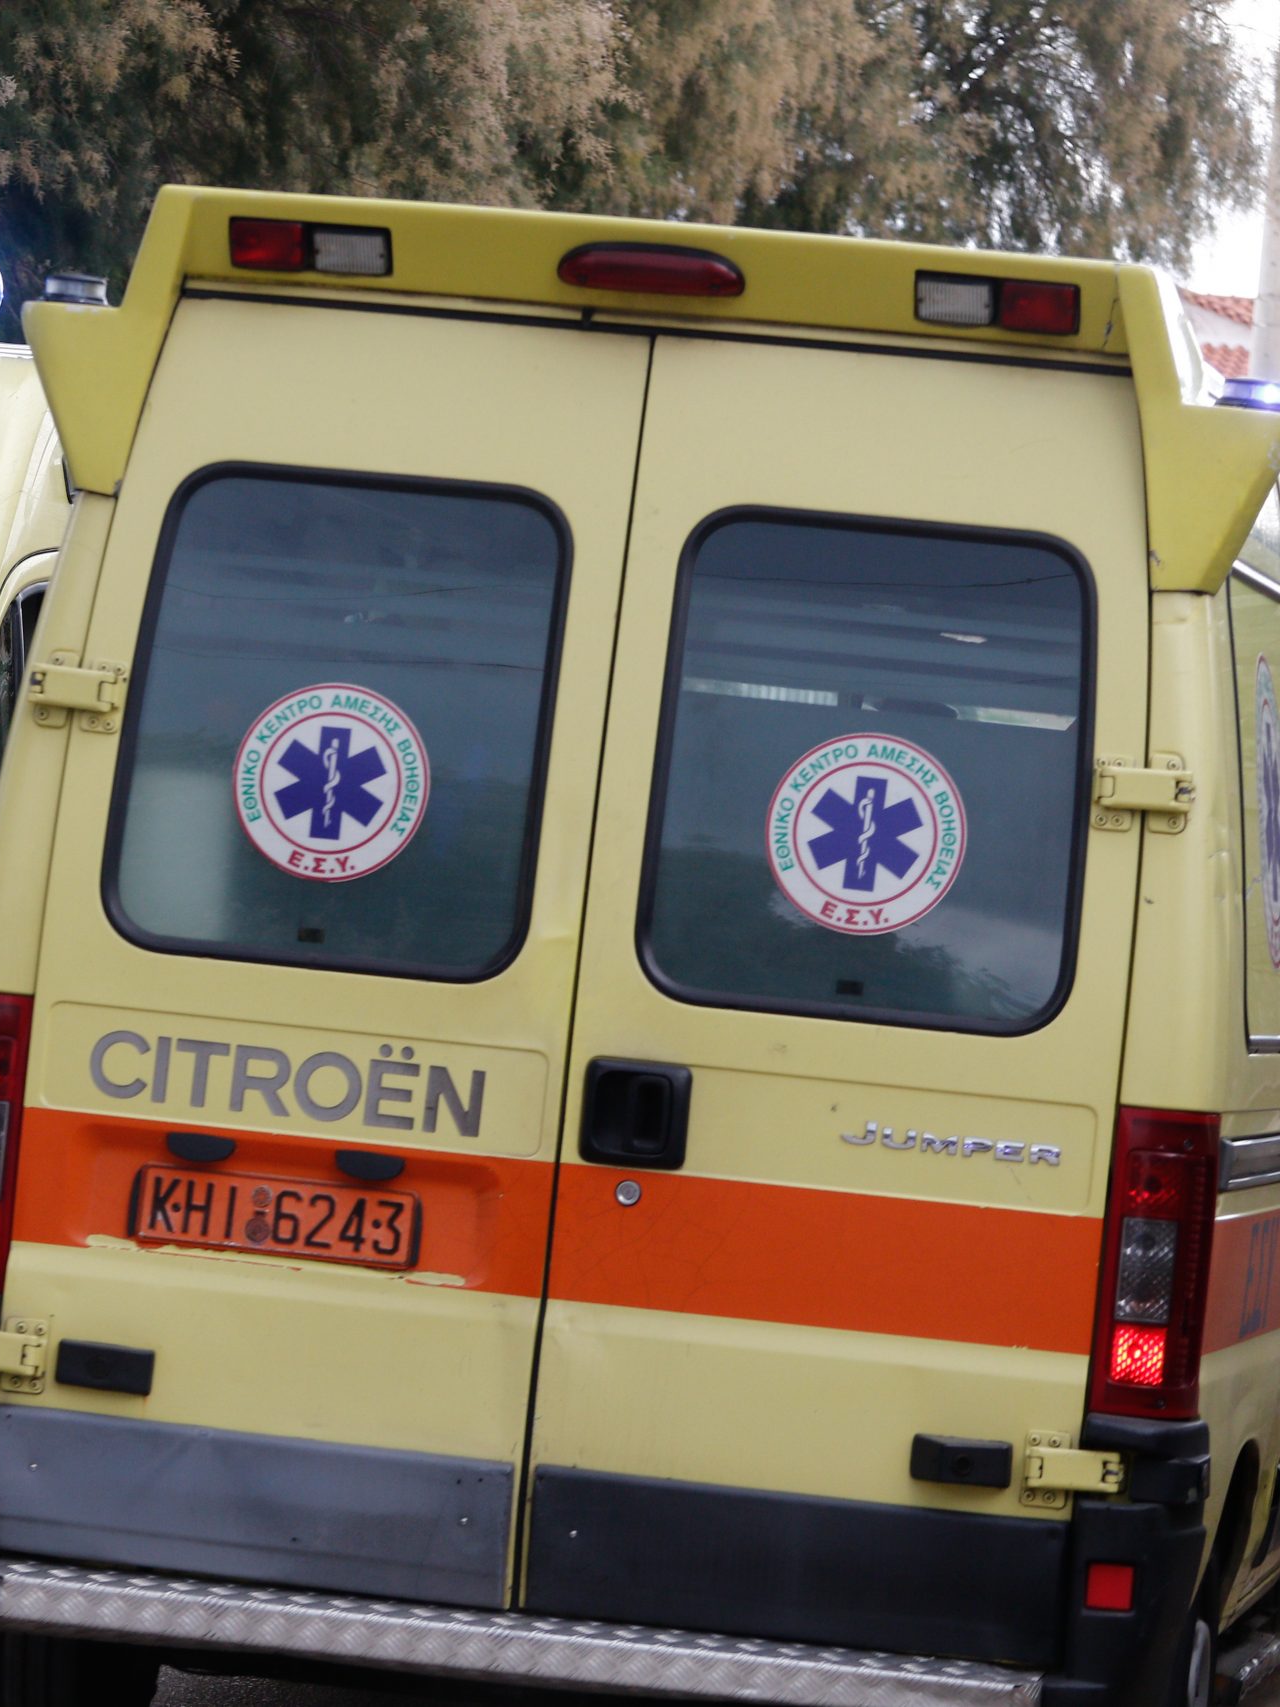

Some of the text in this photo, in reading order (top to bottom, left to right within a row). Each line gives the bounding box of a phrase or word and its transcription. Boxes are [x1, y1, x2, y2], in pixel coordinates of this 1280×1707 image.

[241, 694, 420, 837] ΕΘΝΙΚΟ ΚΕΝΤΡΟ ΑΜΕΣΗΣ ΒΟΗΘΕΙΑΣ
[774, 744, 957, 891] ΕΘΝΙΚΟ ΚΕΝΤΡΟ ΑΜΕΣΗΣ ΒΟΗΘΕΙΑΣ
[90, 1030, 486, 1138] CITROËN
[840, 1120, 1061, 1166] JUMPER
[271, 1188, 407, 1256] 6243
